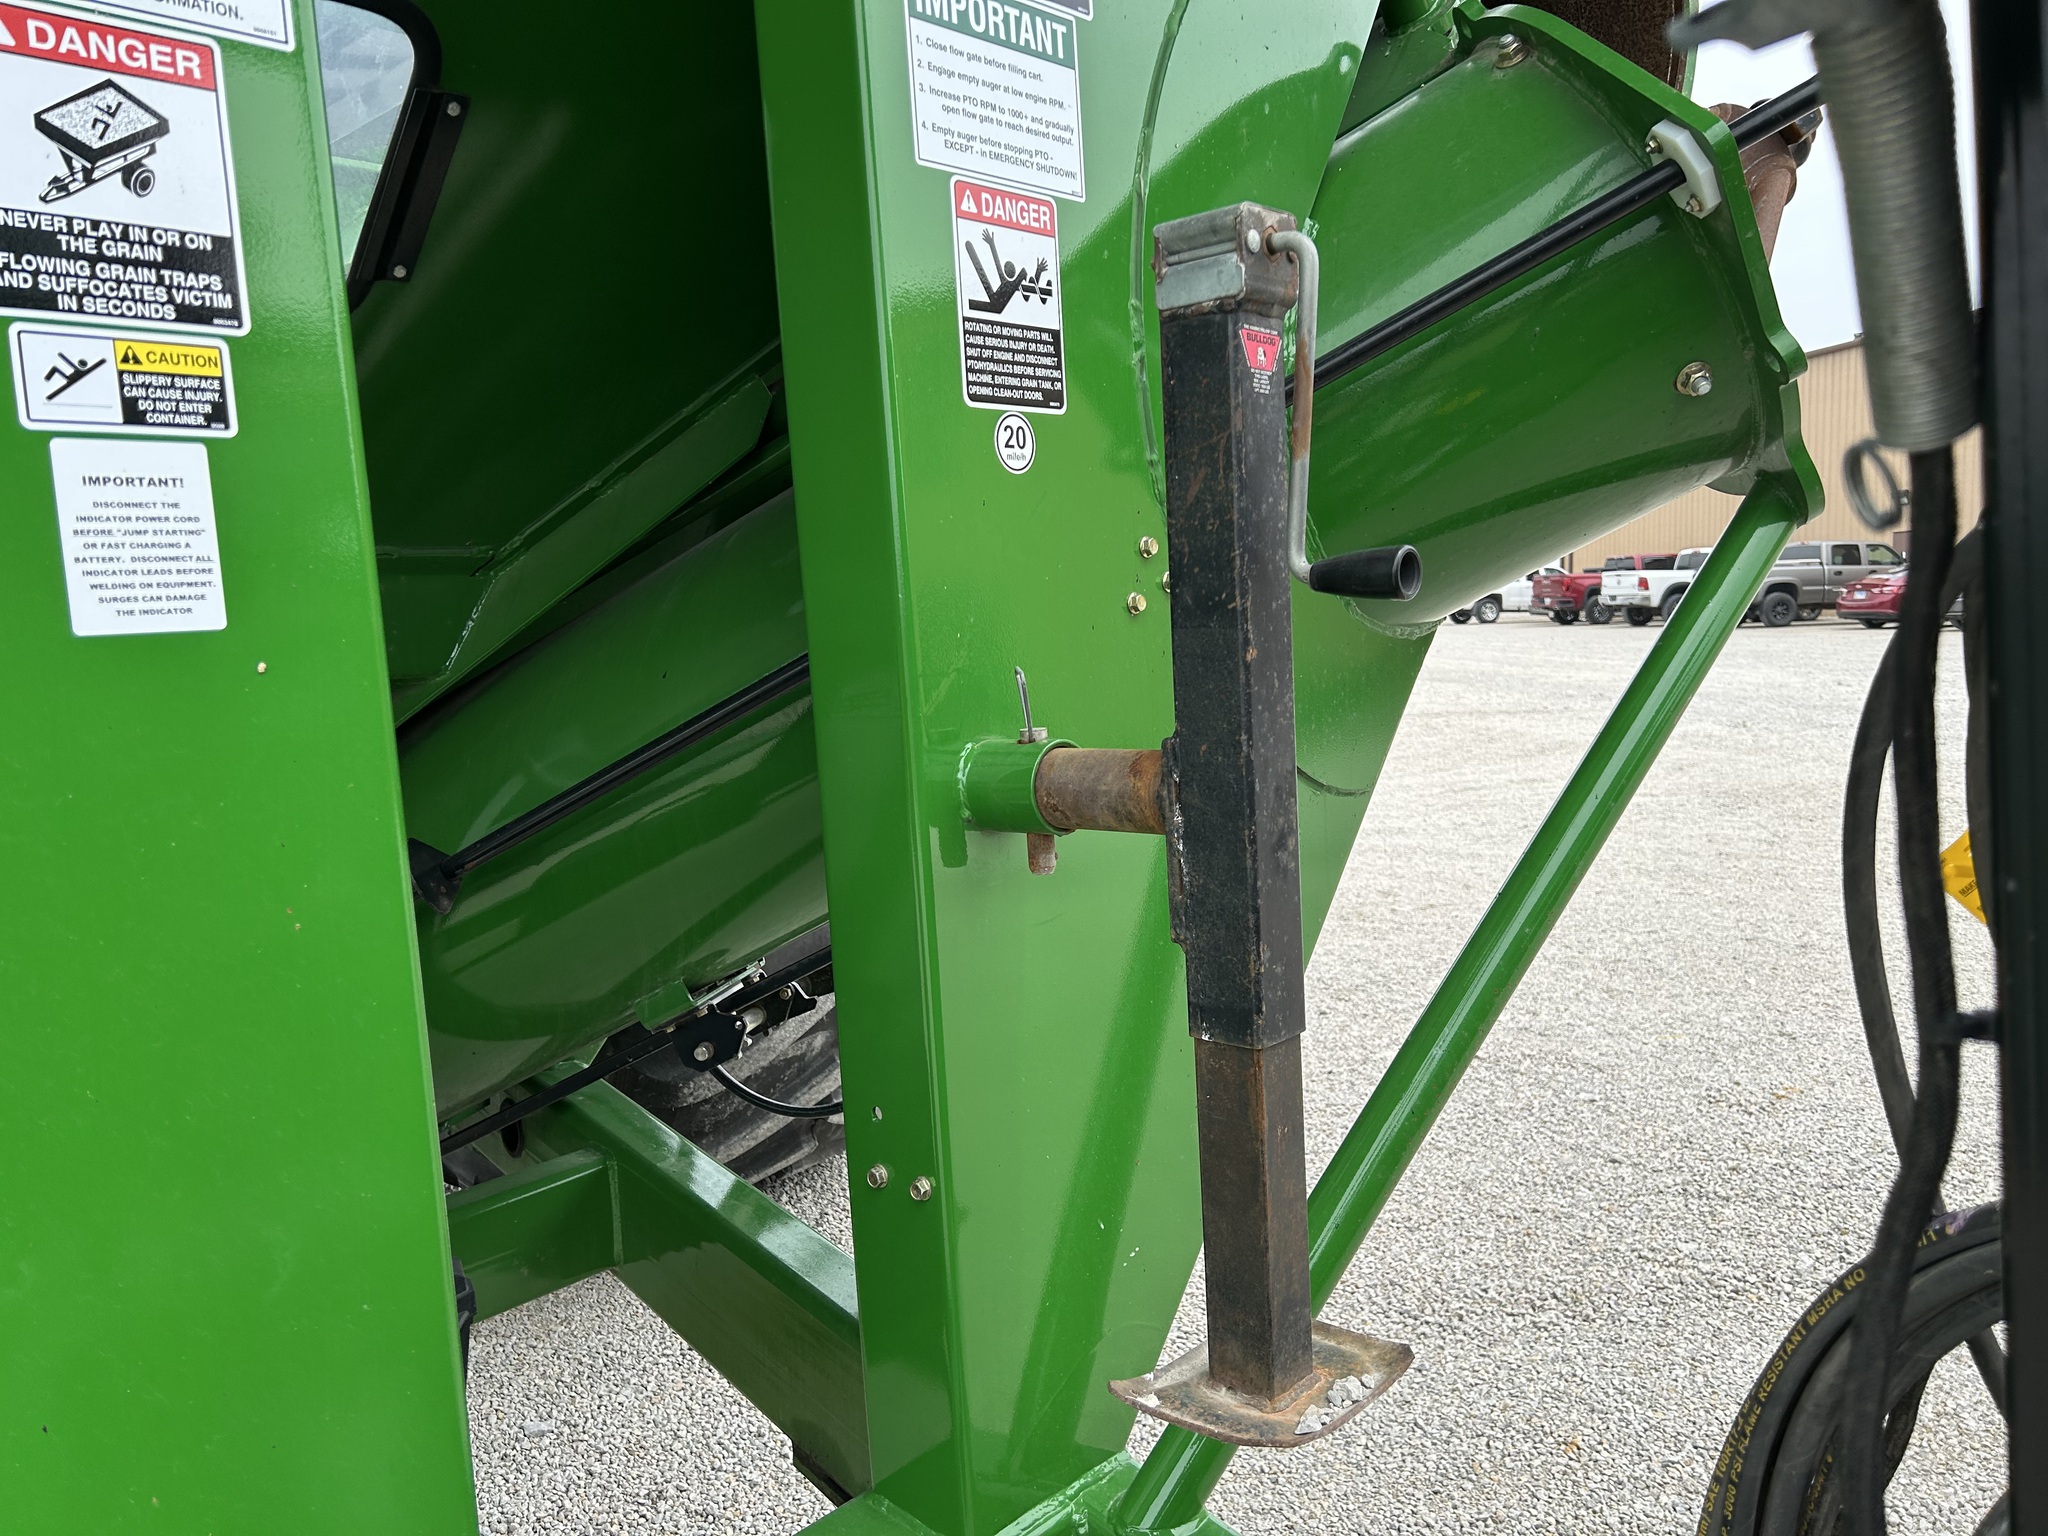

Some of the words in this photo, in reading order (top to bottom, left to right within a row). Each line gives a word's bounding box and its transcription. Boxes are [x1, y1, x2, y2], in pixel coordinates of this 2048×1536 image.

[26, 18, 202, 79] DANGER
[926, 37, 947, 52] Close
[949, 45, 964, 57] flow
[966, 52, 982, 63] gate
[984, 55, 1006, 70] before
[1008, 63, 1027, 79] filling
[927, 61, 955, 79] Engage
[958, 72, 979, 87] empty
[981, 79, 1001, 92] auger
[1003, 85, 1010, 94] at
[1011, 86, 1023, 97] low
[1025, 92, 1047, 105] engine
[929, 85, 961, 103] Increase
[962, 95, 978, 107] PTO
[980, 99, 996, 112] RPM
[998, 105, 1005, 115] to
[1031, 115, 1043, 125] and
[1044, 120, 1074, 136] gradually
[942, 104, 960, 115] open
[962, 107, 977, 120] flow
[979, 114, 994, 124] gate
[996, 117, 1003, 127] to
[1005, 121, 1024, 133] reach
[1025, 126, 1050, 139] desired
[932, 122, 955, 139] Empty
[957, 130, 977, 143] auger
[979, 134, 1002, 149] before
[1004, 142, 1033, 159] stopping
[1034, 149, 1049, 161] PTO
[944, 139, 974, 154] EXCEPT
[989, 150, 1034, 170] EMERGENCY
[981, 192, 1051, 230] DANGER
[0, 209, 68, 233] NEVER
[73, 218, 124, 239] PLAY
[128, 225, 148, 243] IN
[152, 229, 180, 247] OR
[184, 234, 212, 251] ON
[57, 234, 98, 254] THE
[102, 239, 162, 262] GRAIN
[0, 252, 91, 276] FLOWING
[95, 262, 157, 284] GRAIN
[160, 269, 223, 291] TRAPS
[0, 270, 33, 289] ND
[38, 274, 169, 303] SUFFOCATES
[171, 287, 232, 309] VICTIM
[57, 294, 78, 311] IN
[82, 296, 177, 320] SECONDS
[964, 321, 992, 334] ROTATING
[993, 325, 1001, 335] OR
[1002, 326, 1022, 338] MOVING
[1023, 329, 1040, 340] PARTS
[1041, 332, 1053, 342] WILL
[1246, 332, 1276, 347] BULLDOG
[965, 334, 984, 345] CAUSE
[985, 336, 1009, 348] SERIOUS
[1009, 339, 1028, 350] INJURY
[1028, 342, 1036, 352] OR
[146, 351, 218, 369] CAUTION
[966, 346, 981, 357] SHUT
[982, 348, 992, 358] OFF
[993, 350, 1013, 361] ENGINE
[1014, 353, 1025, 363] AND
[1026, 354, 1058, 366] DISCONNECT
[967, 372, 994, 385] MACHINE,
[995, 375, 1020, 387] ENTERING
[1022, 378, 1038, 388] GRAIN
[1054, 381, 1062, 390] OR
[1014, 365, 1034, 376] BEFORE
[1035, 367, 1061, 379] SERVICING
[122, 373, 174, 387] SLIPPERY
[174, 377, 221, 390] SURFACE
[123, 386, 146, 398] CAN
[148, 388, 183, 400] CAUSE
[185, 391, 223, 402] INJURY.
[969, 385, 993, 396] OPENING
[994, 387, 1023, 399] CLEAN-OUT
[138, 399, 154, 411] DO
[156, 401, 177, 412] NOT
[179, 402, 212, 414] ENTER
[146, 412, 208, 425] CONTAINER.
[1004, 425, 1026, 450] 20
[82, 476, 184, 488] IMPORTANT!
[92, 501, 158, 509] DISCONNECT
[75, 515, 133, 523] INDICATOR
[72, 529, 114, 537] BEFORE
[117, 528, 149, 536] "JUMP
[152, 528, 206, 536] STARTING"
[83, 542, 98, 550] OR
[100, 542, 126, 550] FAST
[74, 556, 126, 564] BATTERY.
[130, 555, 194, 563] DISCONNECT
[195, 555, 215, 563] ALL
[82, 569, 139, 577] INDICATOR
[141, 568, 173, 576] LEADS
[176, 567, 214, 575] BEFORE
[89, 582, 136, 590] WELDING
[156, 581, 216, 589] EQUIPMENT.
[98, 595, 140, 604] SURGES
[141, 595, 163, 603] CAN
[165, 594, 207, 602] DAMAGE
[115, 609, 137, 617] THE
[138, 607, 193, 616] INDICATOR
[1724, 1484, 1736, 1520] 3000
[1730, 1455, 1744, 1482] PSI
[1738, 1404, 1762, 1454] FLAME
[1758, 1323, 1807, 1402] RESISTANT
[1806, 1288, 1844, 1326] MSHA
[1705, 1482, 1720, 1512] SAE
